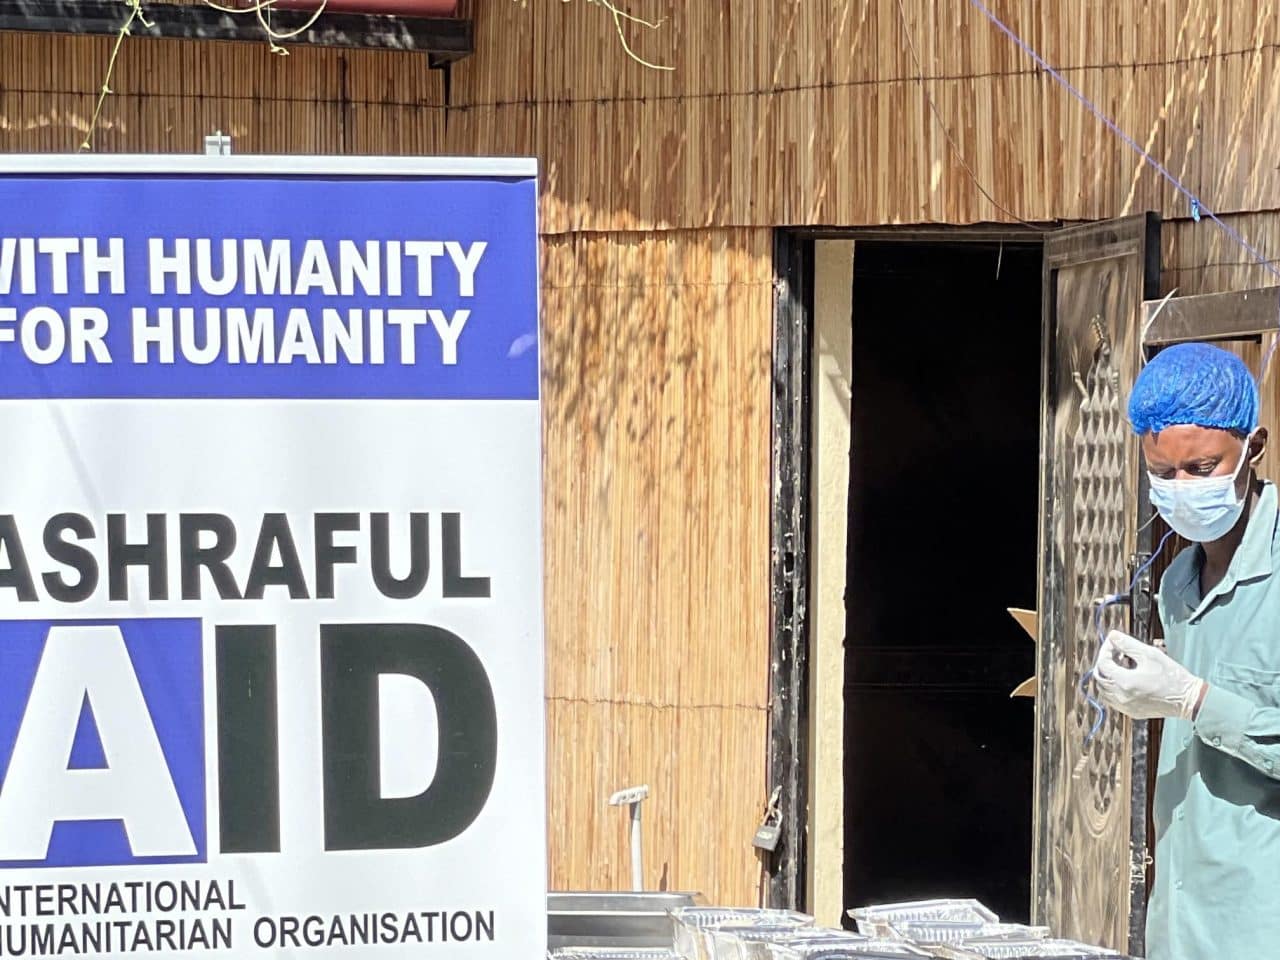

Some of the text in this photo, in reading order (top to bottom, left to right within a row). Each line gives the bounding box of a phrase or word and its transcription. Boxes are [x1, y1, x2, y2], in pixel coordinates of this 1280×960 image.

[0, 237, 488, 297] ITH HUMANITY
[132, 307, 471, 365] HUMANITY
[0, 511, 491, 603] ASHRAFUL
[0, 622, 498, 860] AID
[0, 910, 496, 957] UMANITARIAN ORGANISATION
